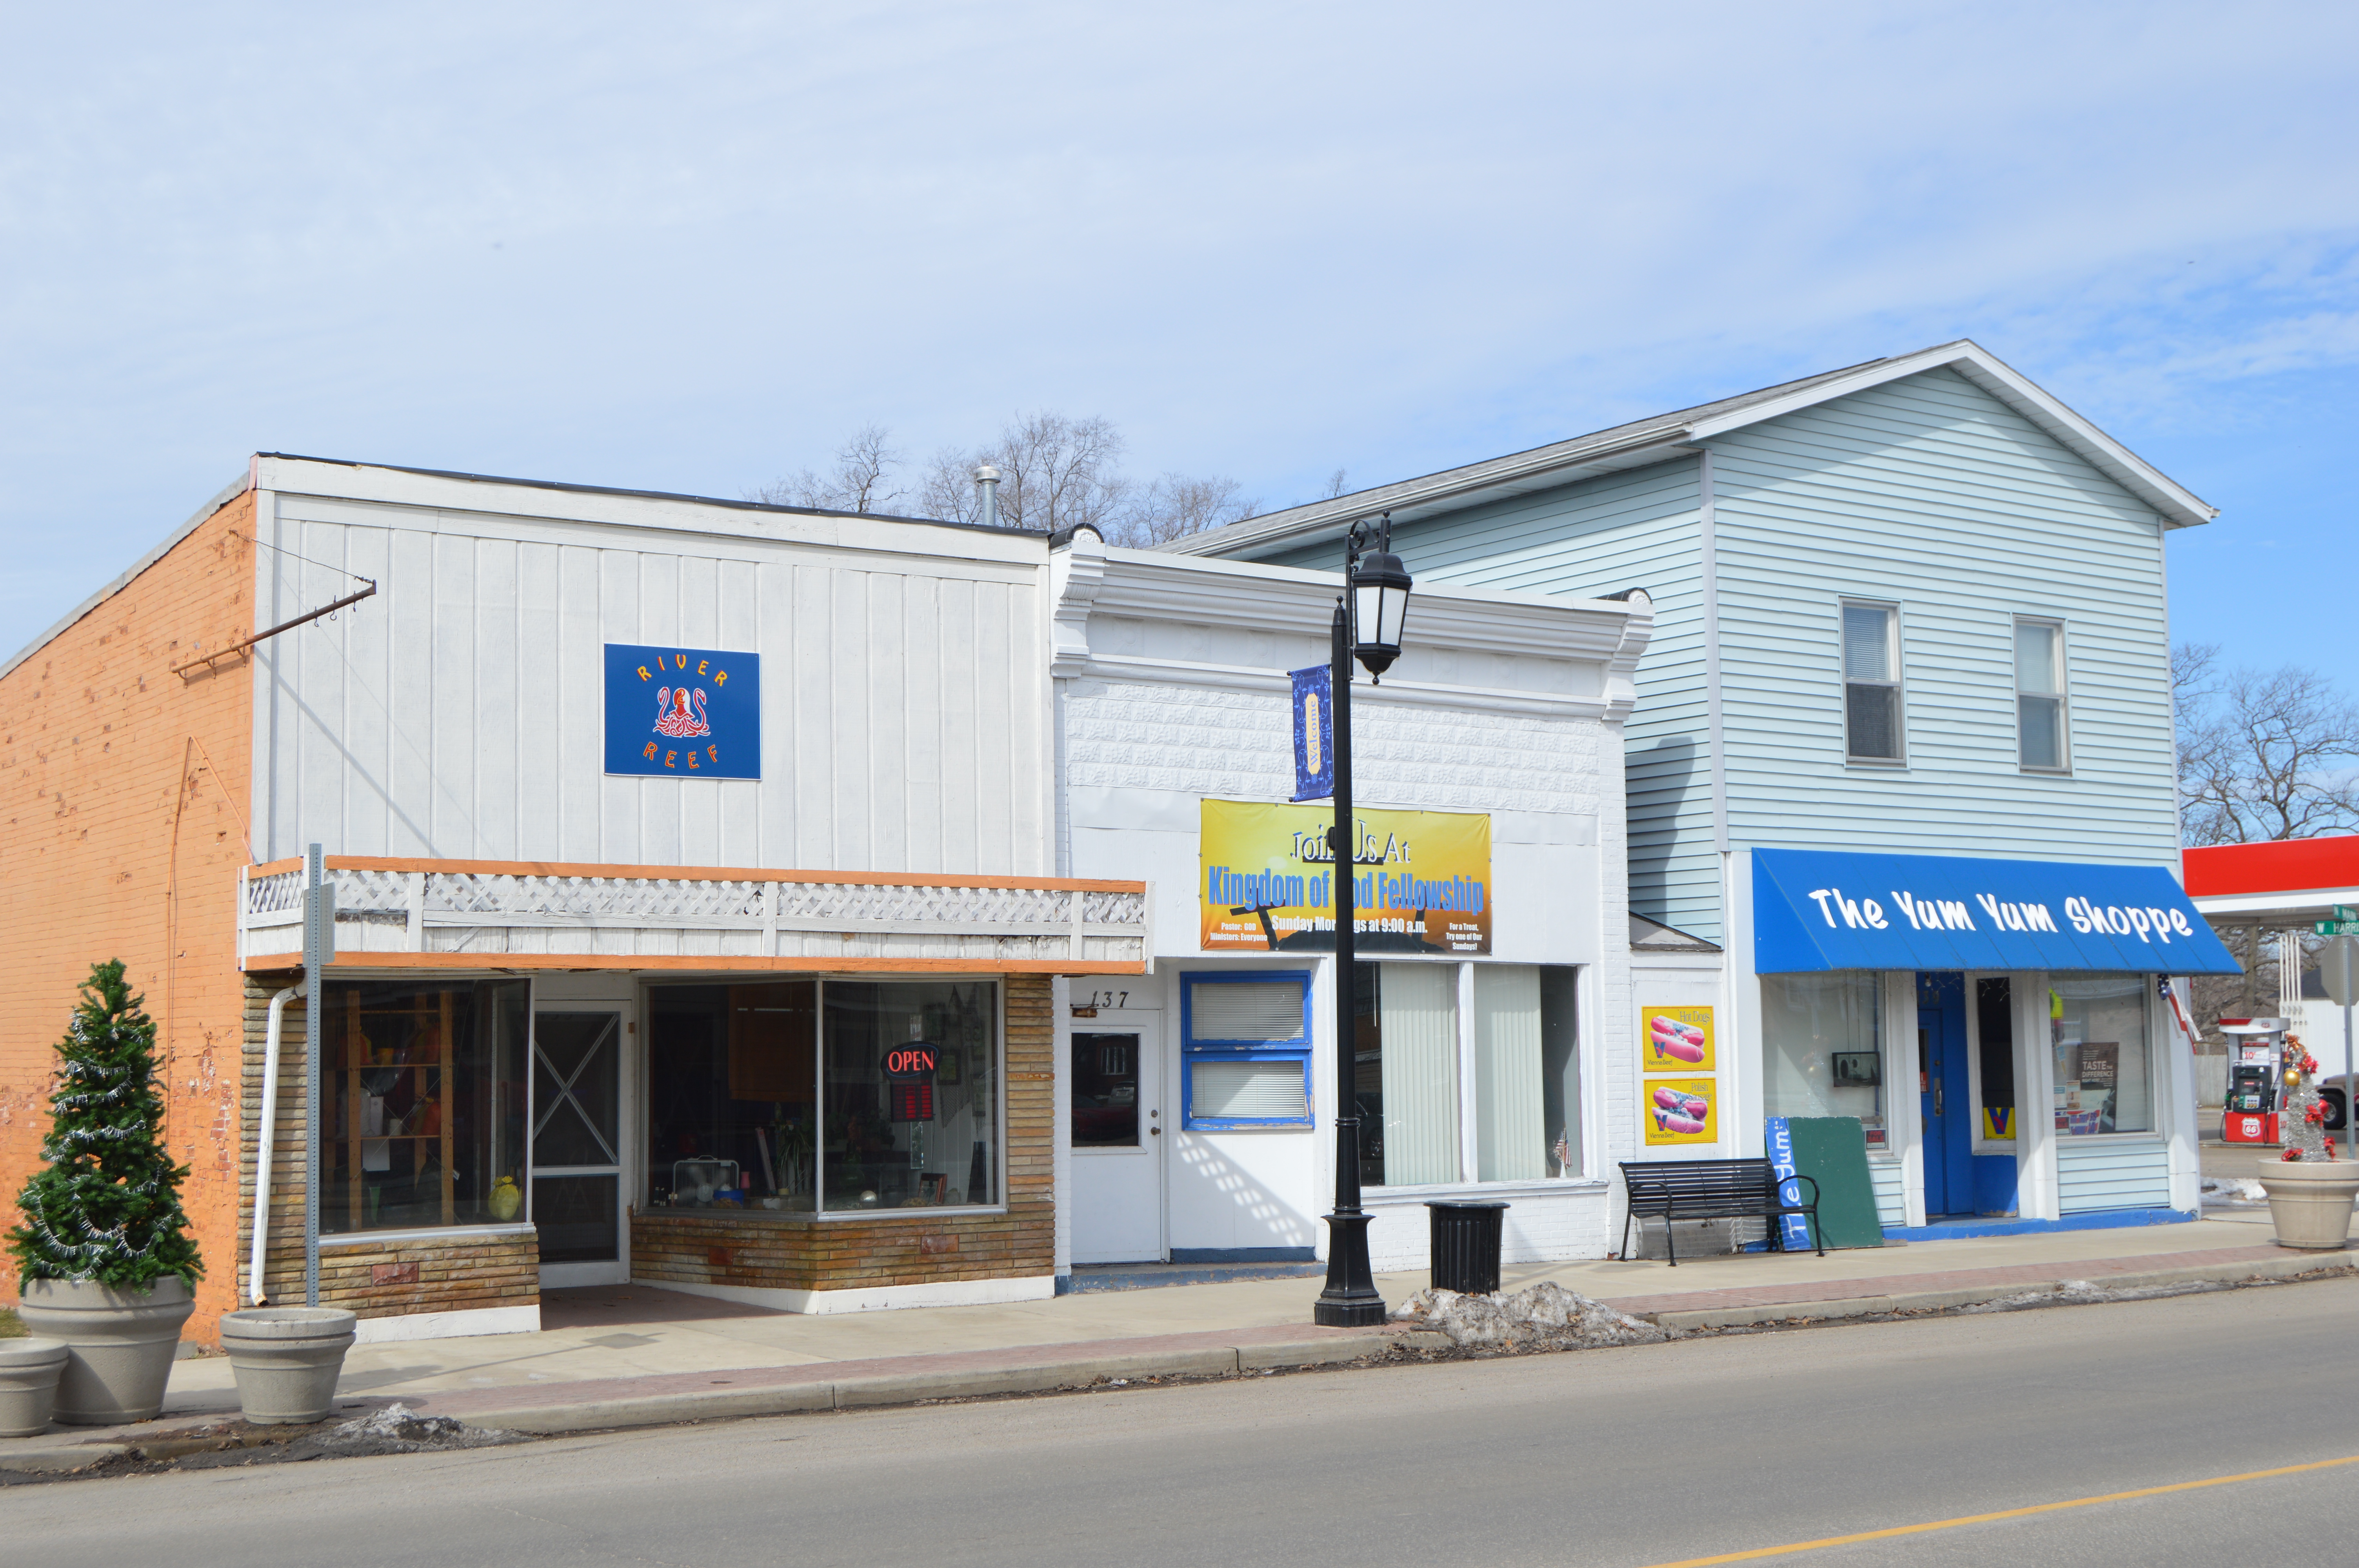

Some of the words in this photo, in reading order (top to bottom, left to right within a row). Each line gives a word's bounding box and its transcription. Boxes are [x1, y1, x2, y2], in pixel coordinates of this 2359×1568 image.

[636, 654, 727, 686] RIVER
[1309, 700, 1318, 767] Welcome
[643, 741, 717, 769] REEF
[1383, 832, 1411, 863] At
[1209, 866, 1304, 911] Kingdom
[1309, 870, 1329, 907] of
[1378, 872, 1484, 916] Fellowship
[1808, 888, 1888, 929] The
[1891, 891, 1976, 931] Yum
[1976, 893, 2059, 933] Yum
[2065, 897, 2193, 944] Shoppe
[1221, 922, 1242, 931] Pastor:
[1244, 923, 1256, 931] GOD
[1272, 915, 1313, 932] Sunday
[1315, 916, 1367, 933] Morgs
[1369, 919, 1379, 932] at
[1381, 918, 1405, 933] 9:00
[1407, 921, 1428, 933] a.m.
[1463, 923, 1479, 931] Treat,
[2317, 922, 2324, 933] W
[1210, 932, 1240, 940] Ministers:
[1241, 933, 1267, 942] Everyone
[1446, 932, 1455, 940] Try
[1452, 942, 1477, 951] Sundays!
[1090, 991, 1129, 1008] 137
[1680, 1011, 1692, 1022] Hot
[1693, 1011, 1710, 1025] Dogs
[888, 1051, 934, 1072] OPEN
[2083, 1060, 2106, 1070] TASTE
[1692, 1082, 1708, 1092] Polish
[1688, 1092, 1712, 1103] Sausage
